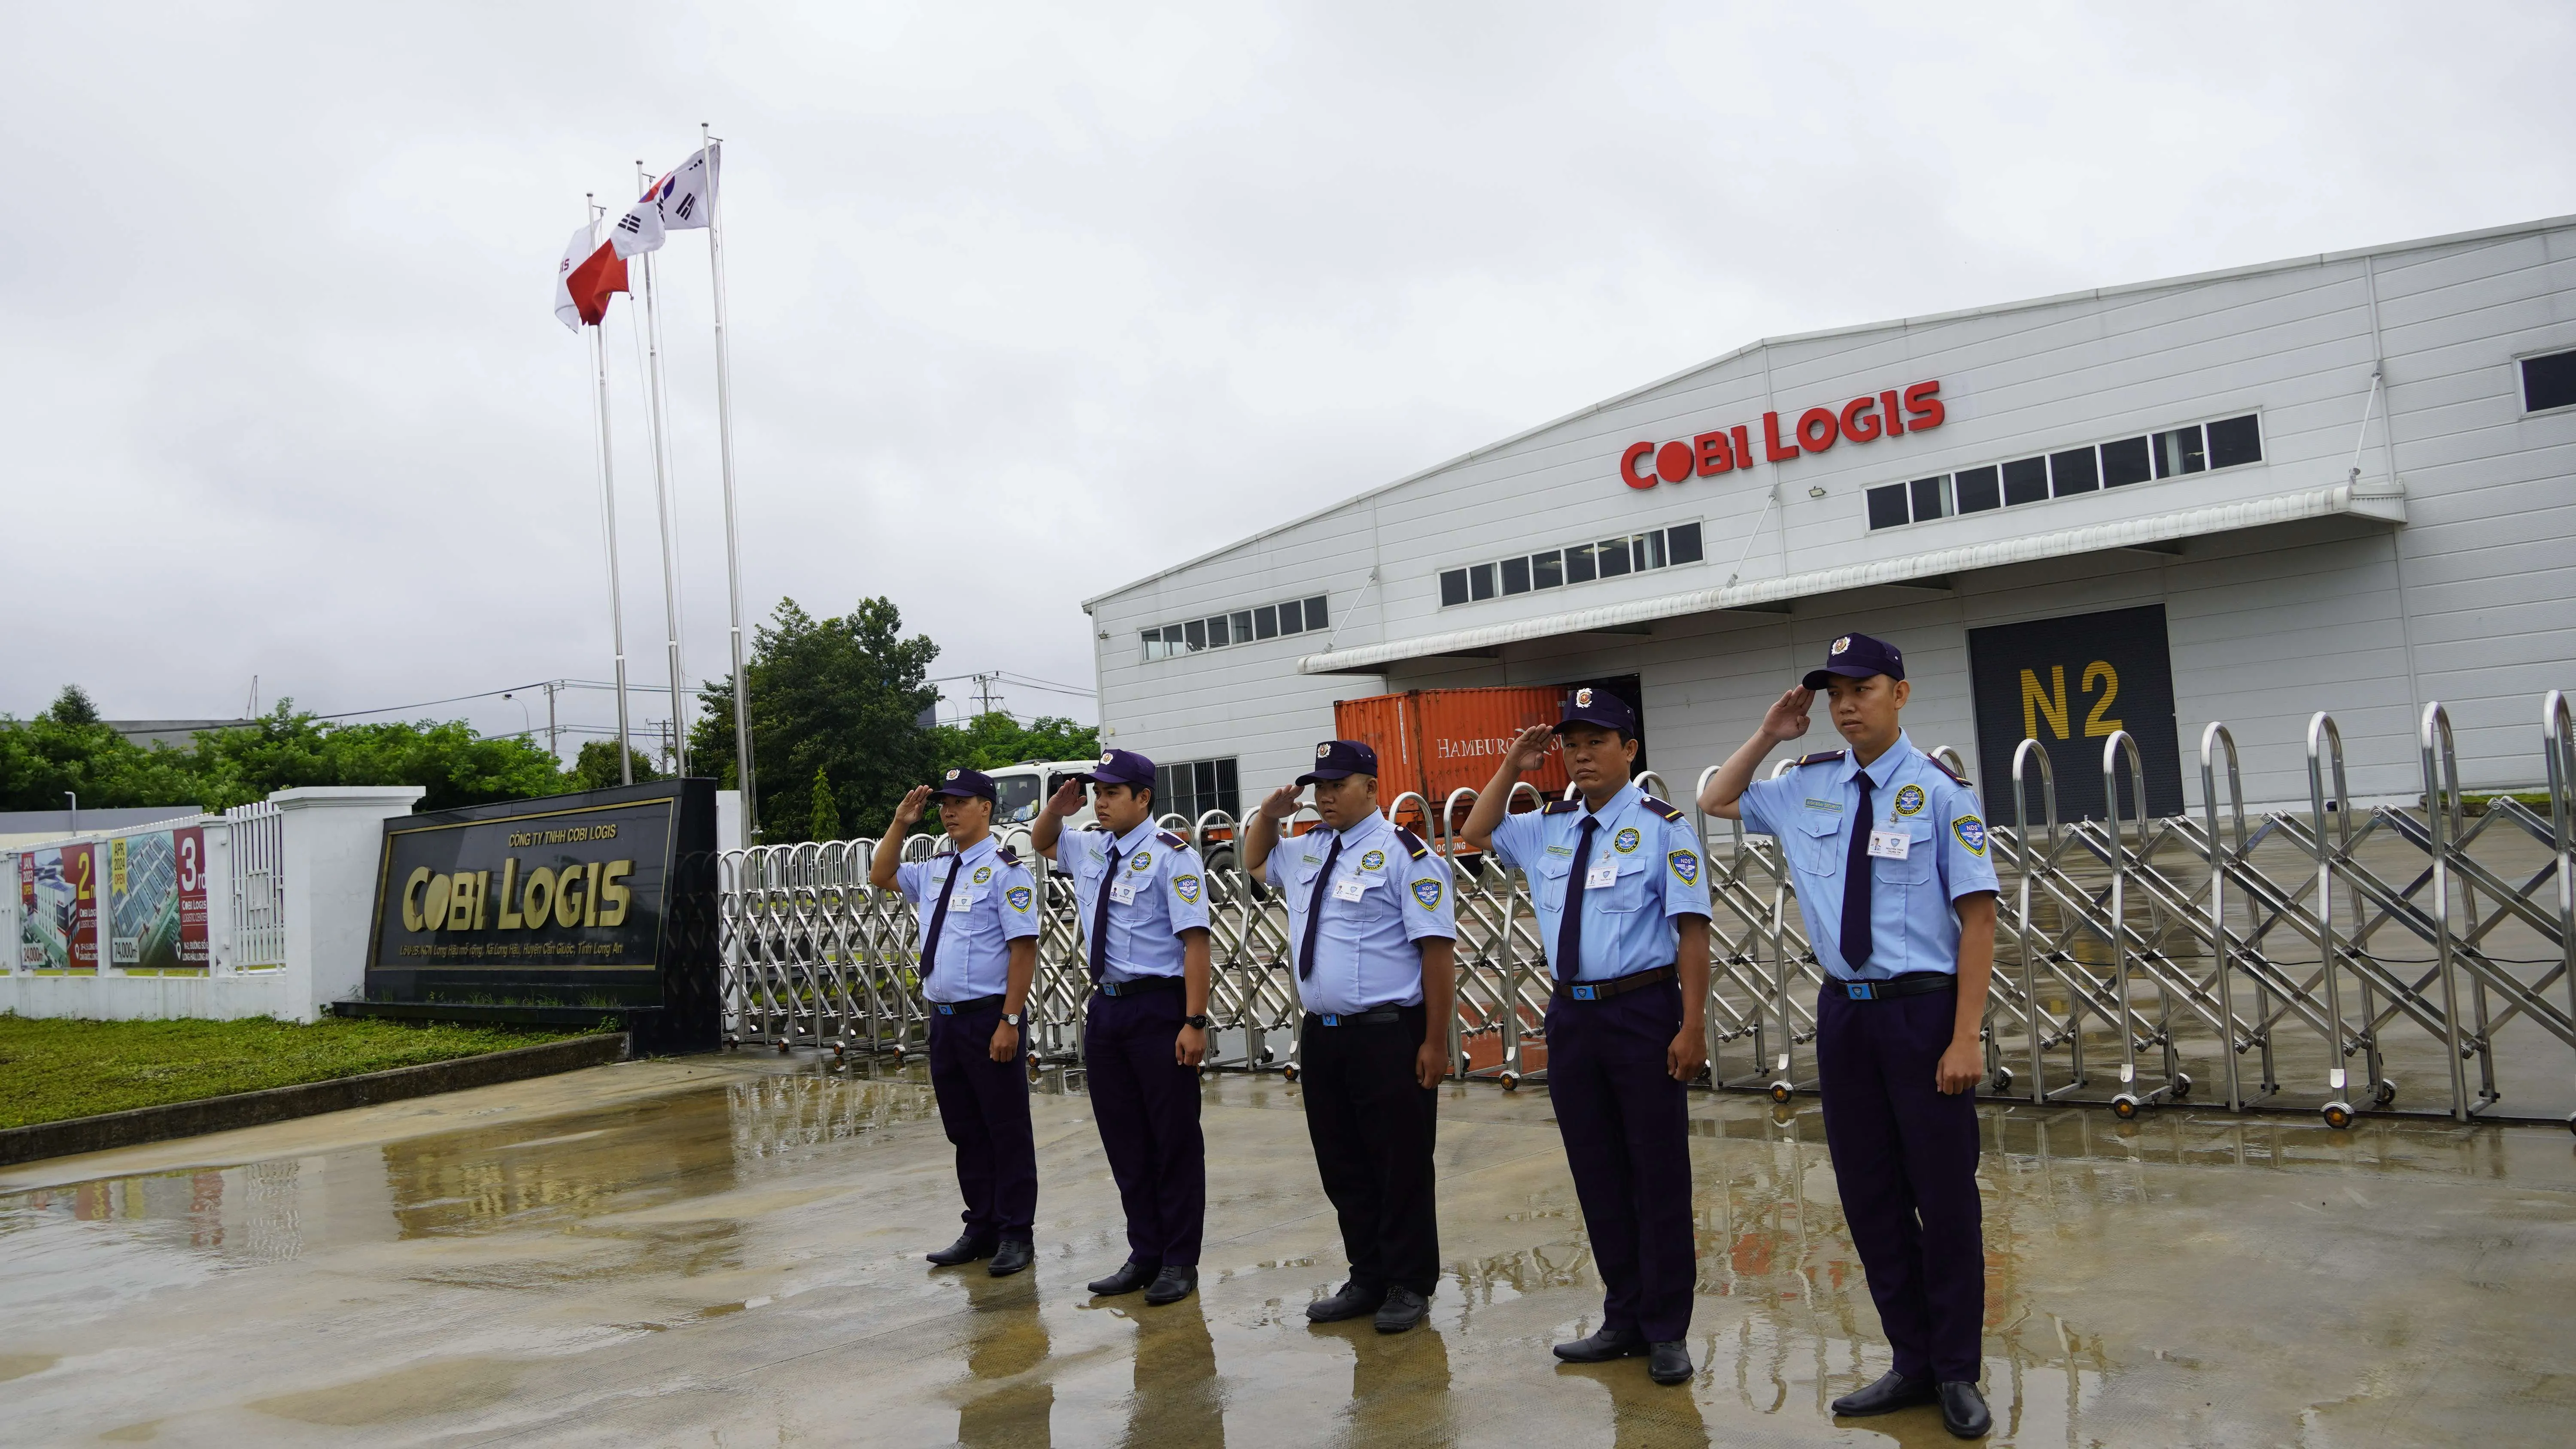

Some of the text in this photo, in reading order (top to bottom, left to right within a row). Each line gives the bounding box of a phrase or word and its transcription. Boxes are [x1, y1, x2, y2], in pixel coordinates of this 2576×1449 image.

[1621, 380, 1945, 489] COBI LOGIS
[1957, 816, 1981, 825] SECURITY
[509, 824, 617, 847] CÔNG TY TNHH COBI LOGIS
[1673, 851, 1695, 859] SECURITY
[114, 858, 125, 870] 2024
[115, 873, 125, 885] OPEN
[403, 858, 634, 932] COBI LOGIS
[182, 900, 207, 910] COBI LOGIS
[434, 945, 448, 958] Long
[494, 944, 508, 958] Long
[593, 943, 610, 957] Long
[613, 943, 622, 954] An
